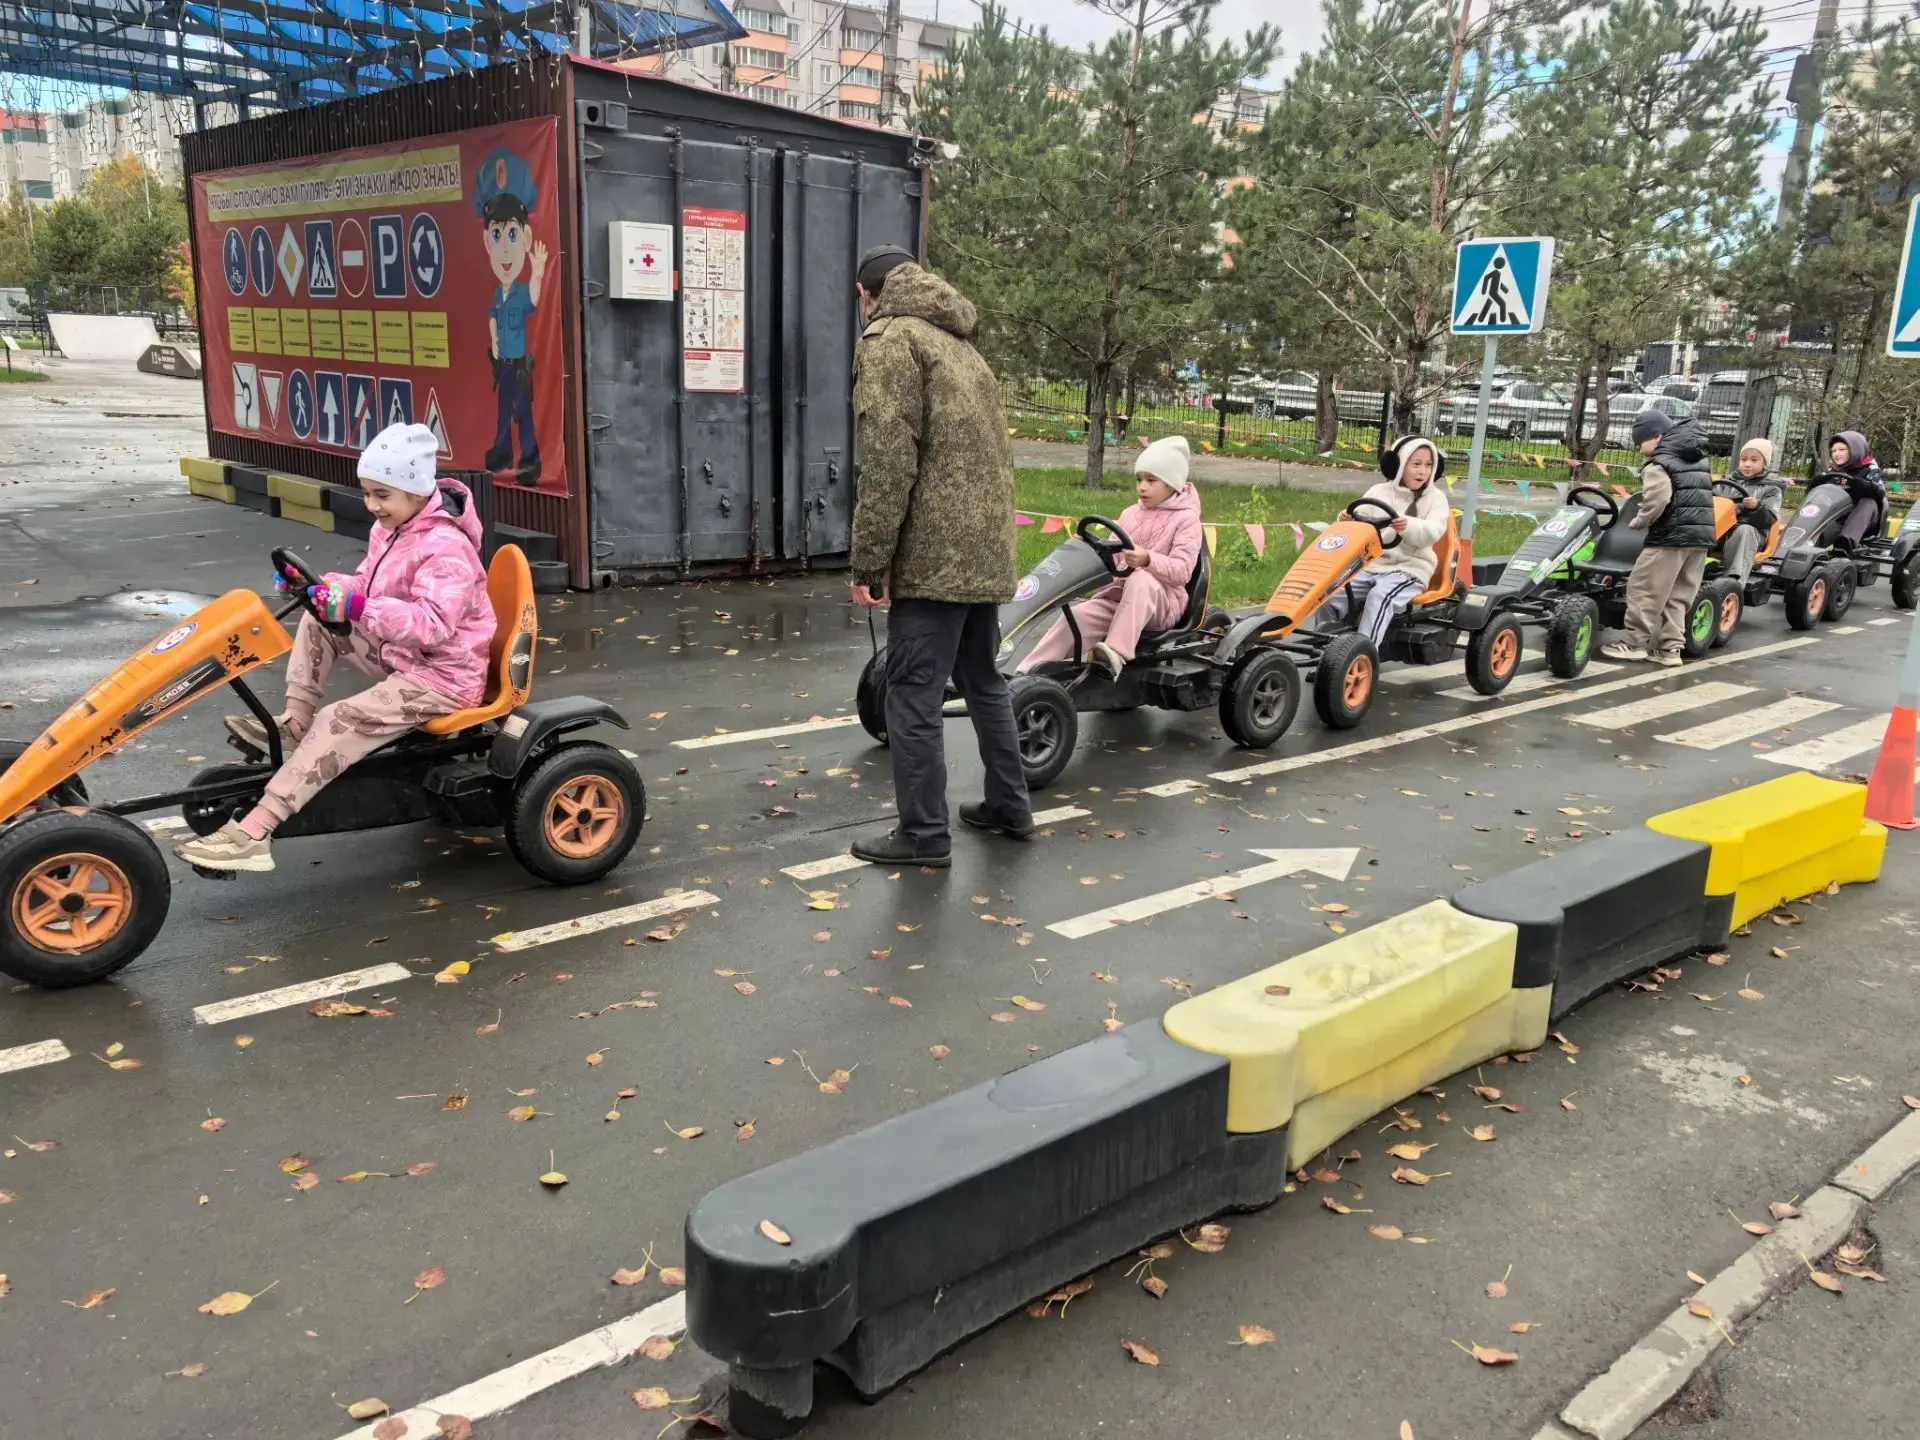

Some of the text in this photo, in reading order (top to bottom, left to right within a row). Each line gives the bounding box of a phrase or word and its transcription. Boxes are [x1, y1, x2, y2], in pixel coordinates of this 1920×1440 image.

[234, 185, 278, 208] СПОКОЙНО
[280, 184, 299, 204] ВАМ
[334, 177, 353, 198] ЭТИ
[355, 172, 387, 196] ЗНАКИ
[389, 169, 421, 193] НАДО
[423, 163, 460, 189] ЗНАТЬ!
